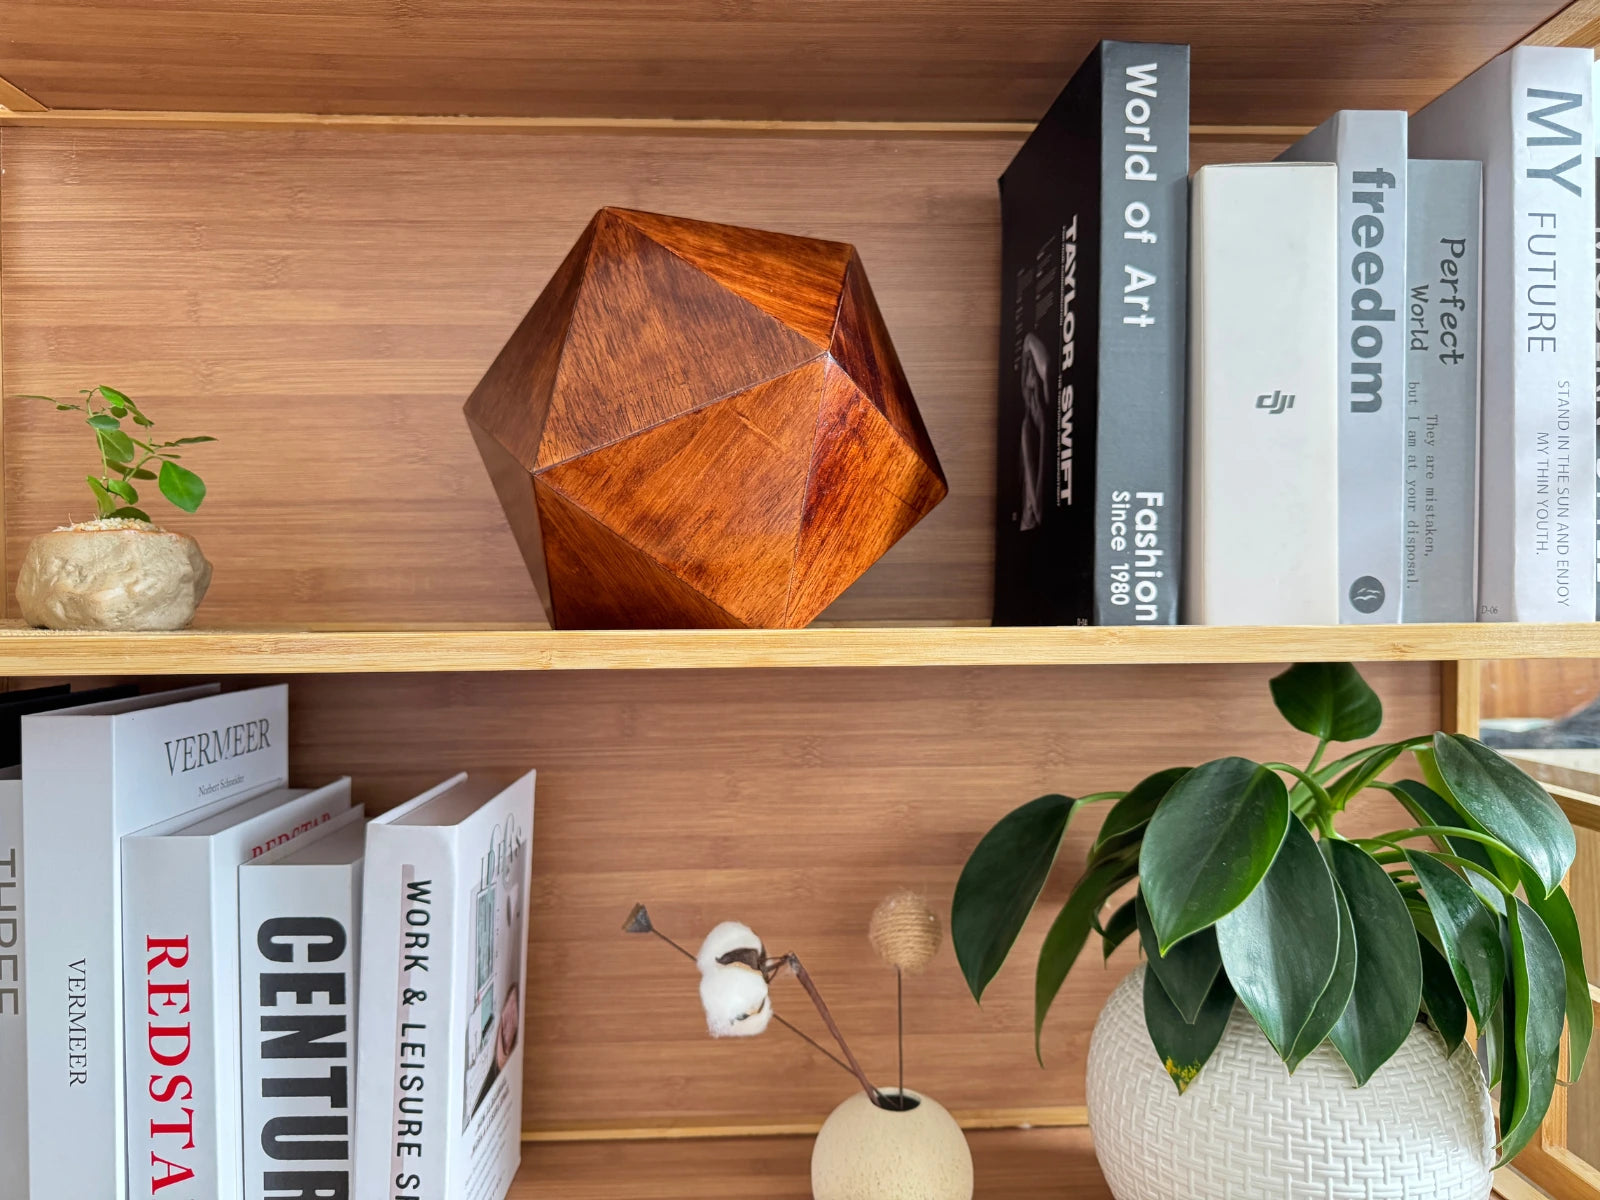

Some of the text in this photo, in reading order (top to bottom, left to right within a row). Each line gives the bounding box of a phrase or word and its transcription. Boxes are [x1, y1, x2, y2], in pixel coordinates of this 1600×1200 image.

[1123, 62, 1158, 328] World of Art
[1527, 87, 1583, 353] MY FUTURE
[1062, 214, 1077, 371] TAYLOR
[1351, 167, 1396, 413] freedom
[1411, 284, 1429, 352] World
[1439, 237, 1466, 365] Perfect
[1060, 385, 1073, 506] SWIFT
[1405, 381, 1421, 589] but I am at your disposal.
[1424, 414, 1439, 557] They are mistaken,
[1536, 432, 1549, 555] MY THIN YOUTH.
[1556, 380, 1570, 607] STAND IN THE SUN AND ENJOY
[1110, 490, 1131, 606] Since 1980
[1135, 491, 1164, 621] Fashion
[164, 717, 272, 777] VERMEER
[68, 957, 88, 1088] VERMEER
[147, 934, 196, 1200] REDSTA
[257, 916, 350, 1200] CENTUR
[395, 880, 432, 1200] WORK & LEISURE S
